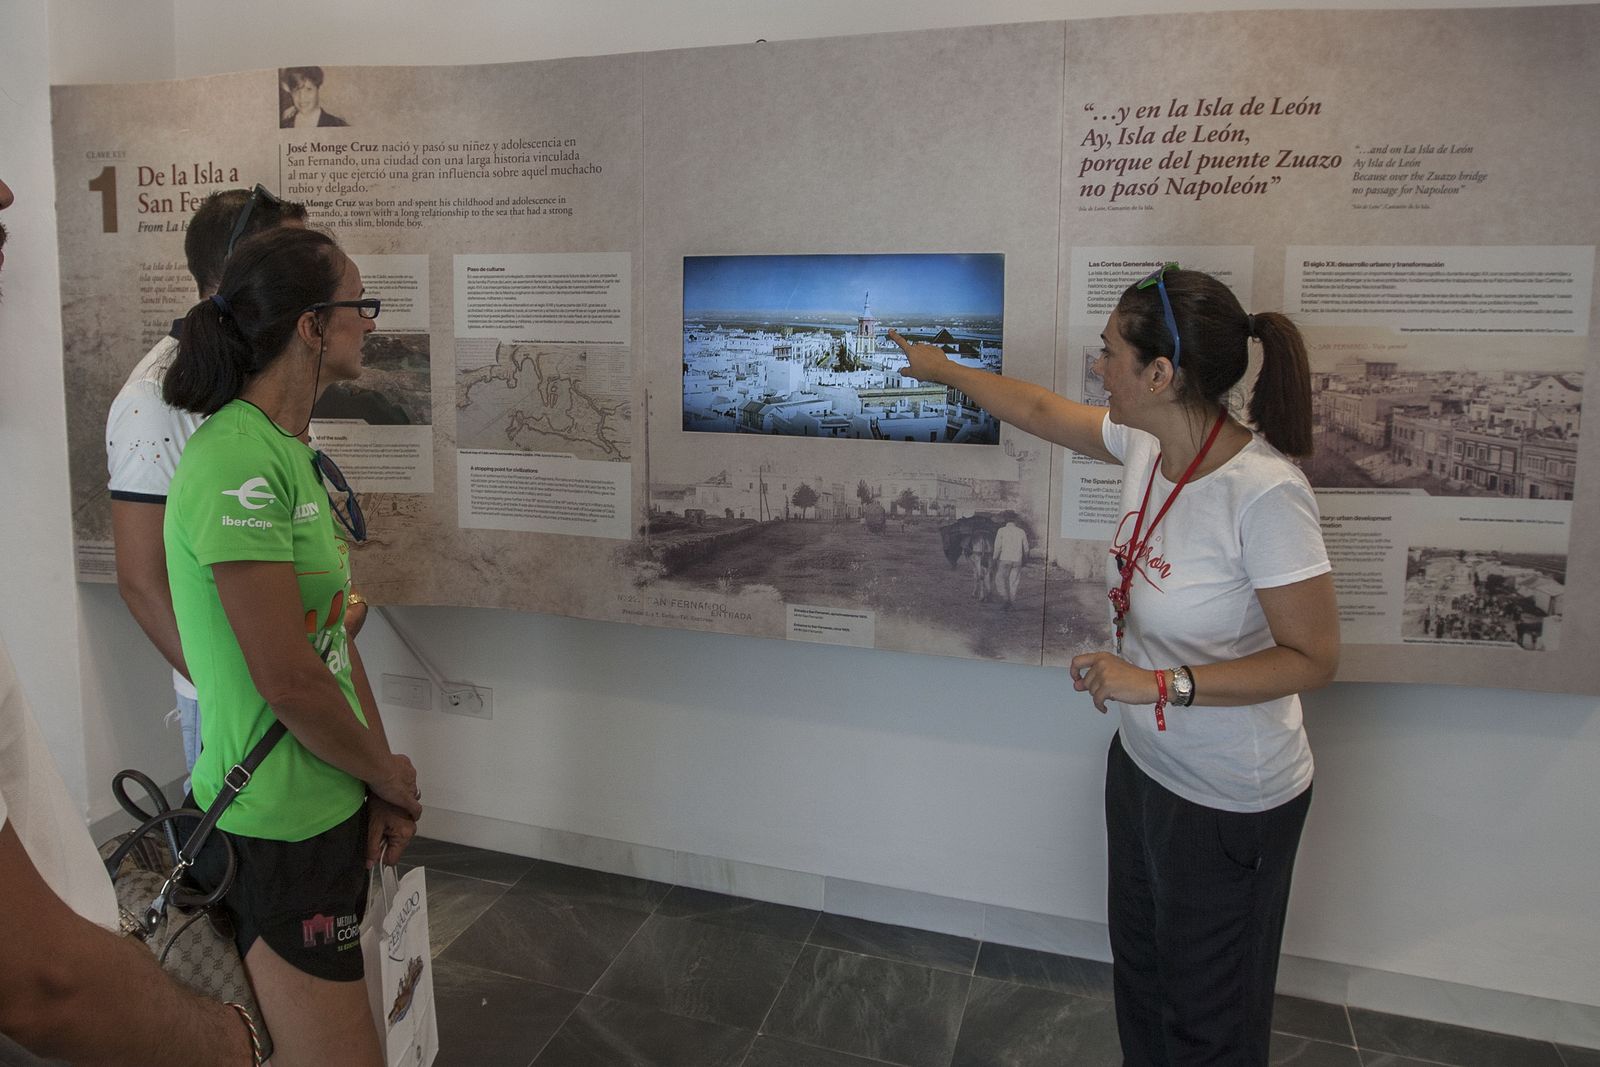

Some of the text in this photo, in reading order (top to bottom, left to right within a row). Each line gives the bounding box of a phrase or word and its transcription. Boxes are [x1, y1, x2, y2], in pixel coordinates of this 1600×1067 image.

[1136, 104, 1161, 119] en
[1168, 98, 1188, 118] la
[1194, 97, 1234, 117] Isla
[1240, 96, 1264, 116] de
[1270, 96, 1322, 116] León
[1080, 122, 1250, 152] Ay, Isla de León,
[286, 136, 576, 156] José Monge Cruz nació y pasó su niñez y adolescencia en
[1404, 145, 1415, 154] La
[1418, 144, 1434, 154] Isla
[1437, 144, 1448, 154] de
[1450, 144, 1473, 154] León
[287, 149, 581, 169] San Fernando, una ciudad con una larga historia vinculada
[1078, 150, 1342, 178] porque del puente Zuazo
[1353, 158, 1421, 170] Ay Isla de León
[137, 161, 239, 187] De la Isla a
[288, 162, 602, 182] al mar y que ejerció una gran influencia sobre aquel muchacho
[1353, 171, 1386, 181] Because
[1410, 171, 1424, 181] the
[1426, 171, 1456, 181] Zuazo
[1458, 171, 1488, 183] bridge
[288, 182, 368, 196] rubio y delgado.
[1079, 182, 1106, 197] no
[1110, 176, 1159, 202] pasó
[1365, 187, 1398, 197] passage
[1399, 185, 1412, 197] for
[88, 166, 118, 233] 1
[137, 192, 174, 214] San
[305, 199, 333, 209] Monge
[335, 198, 356, 207] Cruz
[375, 198, 395, 207] born
[398, 198, 413, 206] and
[415, 199, 437, 208] spent
[439, 198, 451, 206] his
[452, 197, 493, 206] childhood
[496, 197, 510, 205] and
[512, 196, 556, 205] adolescence
[558, 195, 566, 203] in
[307, 208, 343, 218] ernando,
[350, 209, 371, 217] town
[374, 208, 392, 216] with
[401, 208, 419, 218] long
[421, 208, 469, 218] relationship
[481, 208, 494, 216] the
[509, 207, 524, 215] that
[526, 206, 541, 215] had
[549, 207, 573, 216] strong
[137, 221, 163, 232] From
[165, 220, 179, 232] La
[338, 219, 353, 227] this
[355, 219, 375, 228] slim,
[376, 218, 404, 227] blonde
[406, 218, 423, 229] boy.
[1311, 261, 1325, 269] siglo
